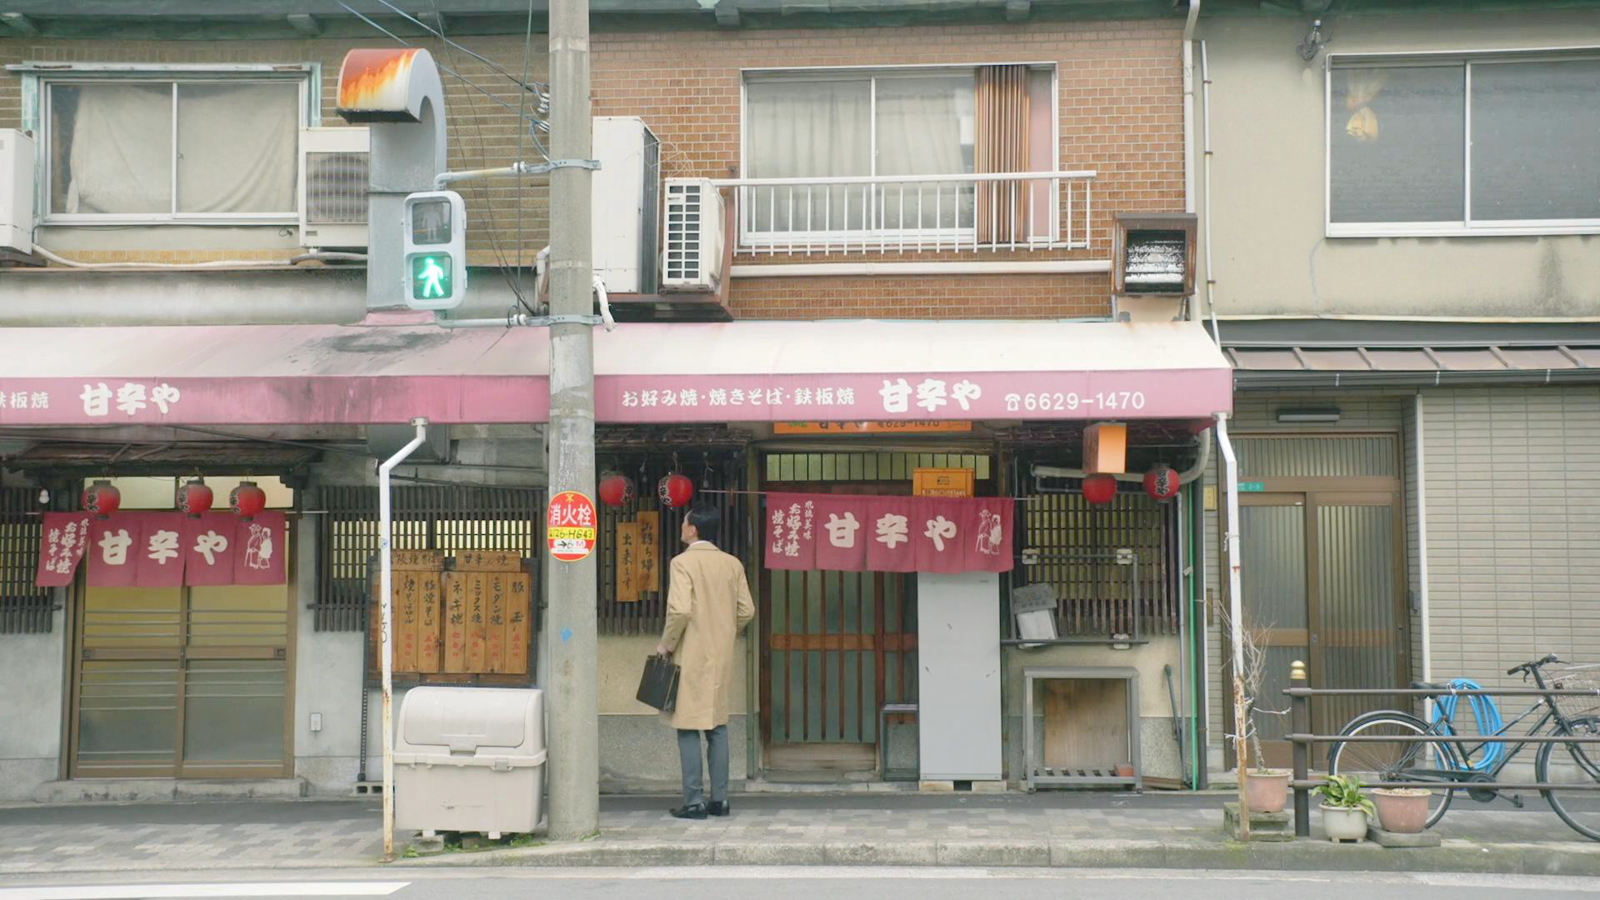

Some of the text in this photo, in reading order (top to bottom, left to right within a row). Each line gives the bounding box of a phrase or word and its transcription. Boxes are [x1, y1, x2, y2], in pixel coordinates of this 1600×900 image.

[80, 382, 181, 416] 甘辛や
[878, 378, 982, 413] 甘辛や
[1023, 391, 1146, 411] 6629-1470
[549, 503, 592, 526] 消火栓
[824, 511, 957, 551] 甘辛や
[98, 528, 228, 565] 甘辛や
